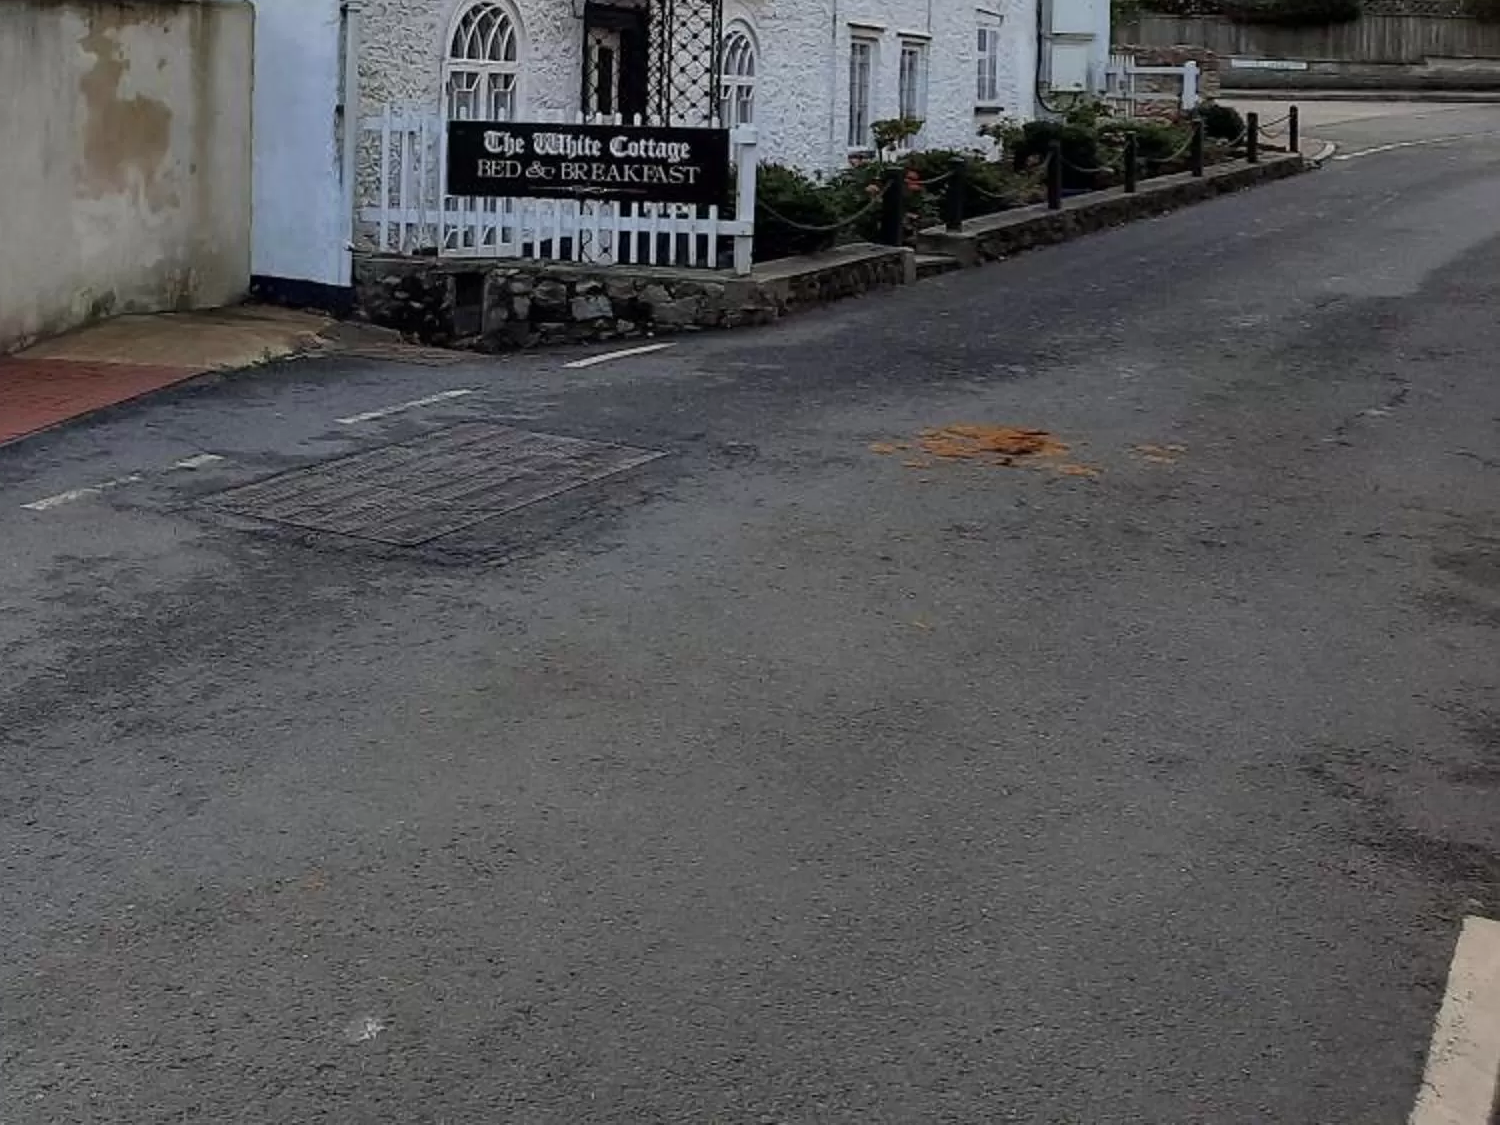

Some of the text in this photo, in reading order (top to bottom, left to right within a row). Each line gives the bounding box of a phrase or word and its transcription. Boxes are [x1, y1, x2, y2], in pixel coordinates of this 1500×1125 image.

[483, 130, 691, 163] The White Cottage
[477, 158, 701, 184] BED & BREAKFAST
